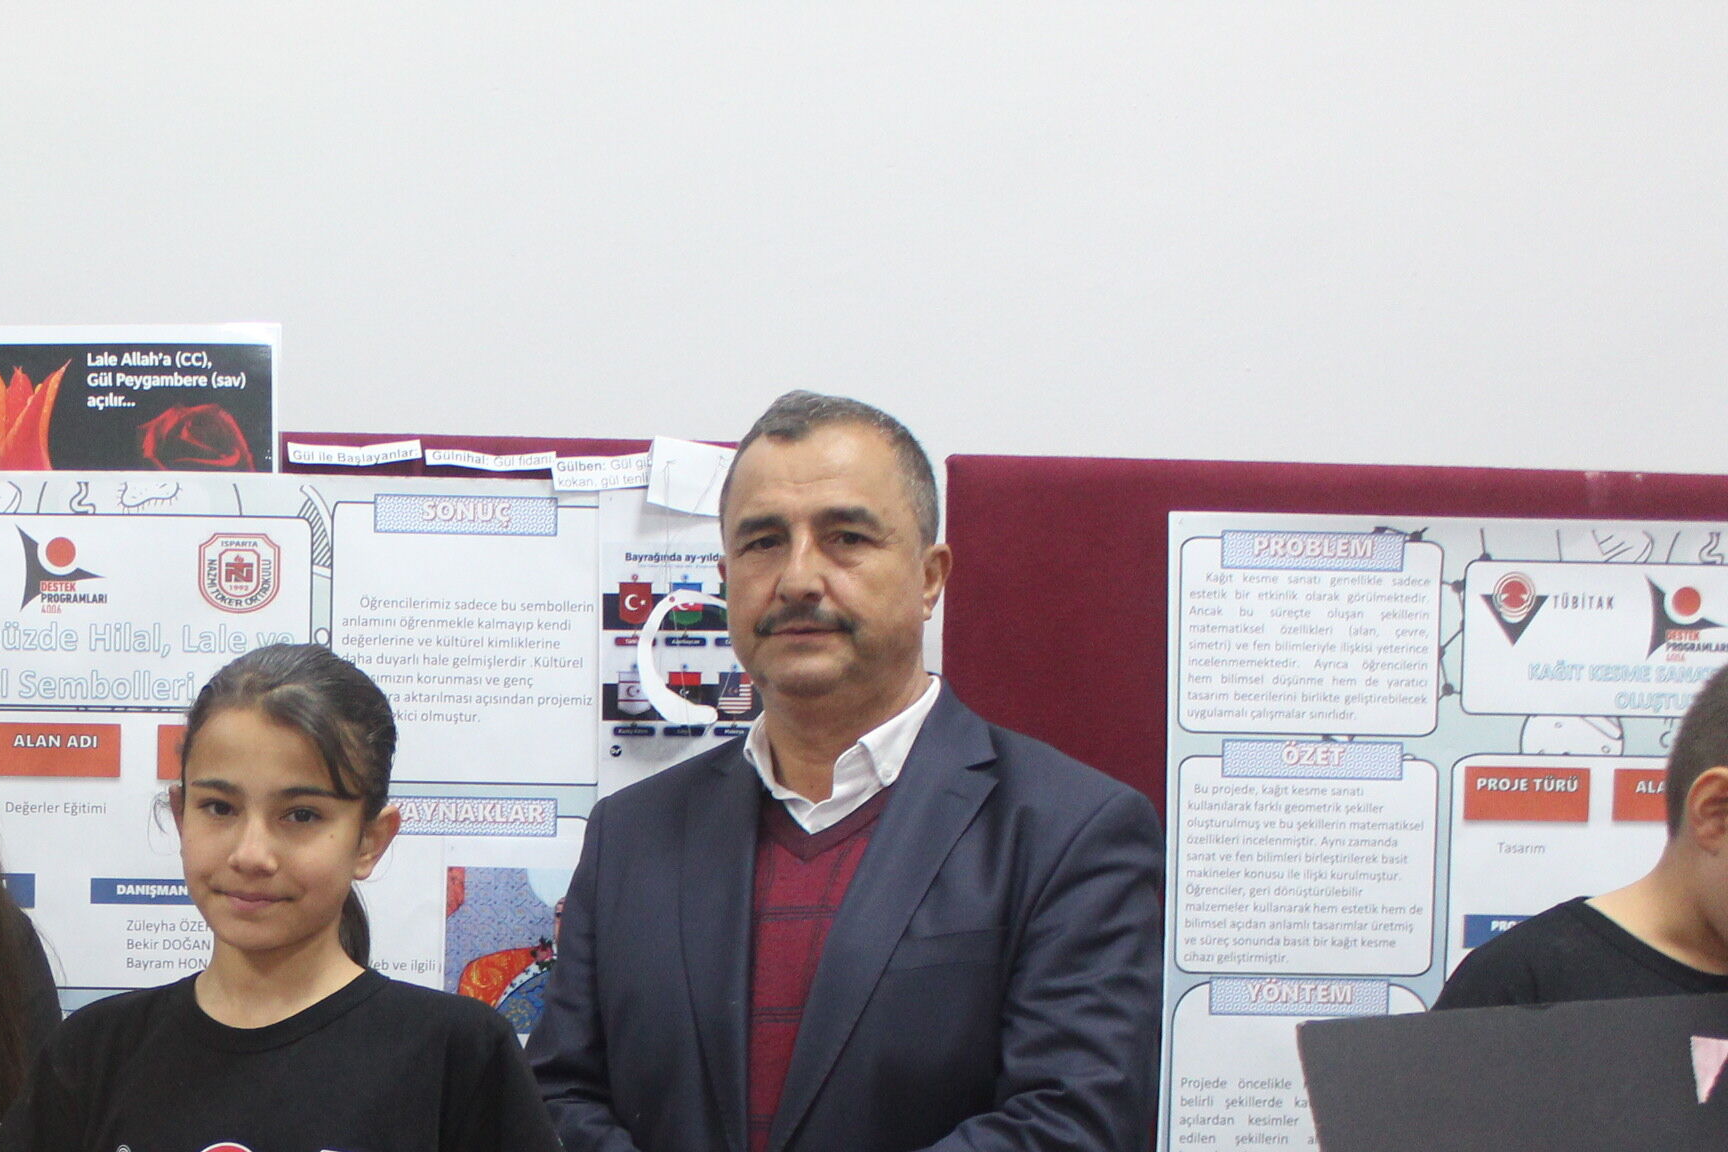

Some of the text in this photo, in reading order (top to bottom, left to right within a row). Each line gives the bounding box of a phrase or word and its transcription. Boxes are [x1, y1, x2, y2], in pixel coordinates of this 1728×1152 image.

[87, 352, 117, 367] Lale
[175, 352, 212, 370] (CC),
[87, 373, 246, 391] Gül Peygambere (sav)
[87, 393, 136, 410] açılır...
[293, 448, 418, 466] Gül ile Başlayanlar:
[432, 451, 489, 465] Gülnihal:
[556, 460, 606, 473] Gülben:
[421, 501, 512, 529] SONUÇ
[1253, 534, 1375, 559] PROBLEM
[625, 552, 682, 563] Bayrağında
[41, 582, 76, 592] DESTEK
[41, 593, 107, 603] PROGRAMLARI
[360, 595, 594, 613] Öğrencilerimiz sadece bu sembollerin
[1553, 592, 1614, 610] TÜBİTAK
[342, 614, 571, 633] anlamını öğrenmekle kalmayıp kendi
[88, 622, 172, 659] Hilal,
[183, 623, 247, 654] Lale
[341, 633, 560, 650] değerlerine ve kültürel kimliklerine
[18, 670, 195, 701] Sembolleri
[13, 735, 98, 748] ALAN ADI
[1282, 741, 1347, 767] ÖZET
[1477, 775, 1578, 792] PROJE TÜRÜ
[6, 802, 107, 816] Değerler Eğitimi
[1497, 842, 1545, 854] Tasarım
[116, 885, 188, 898] DANIŞMAN
[127, 919, 176, 934] Züleyha
[127, 937, 211, 951] Bekir DOĞAN
[126, 957, 174, 971] Bayram
[1246, 978, 1354, 1004] YÖNTEM
